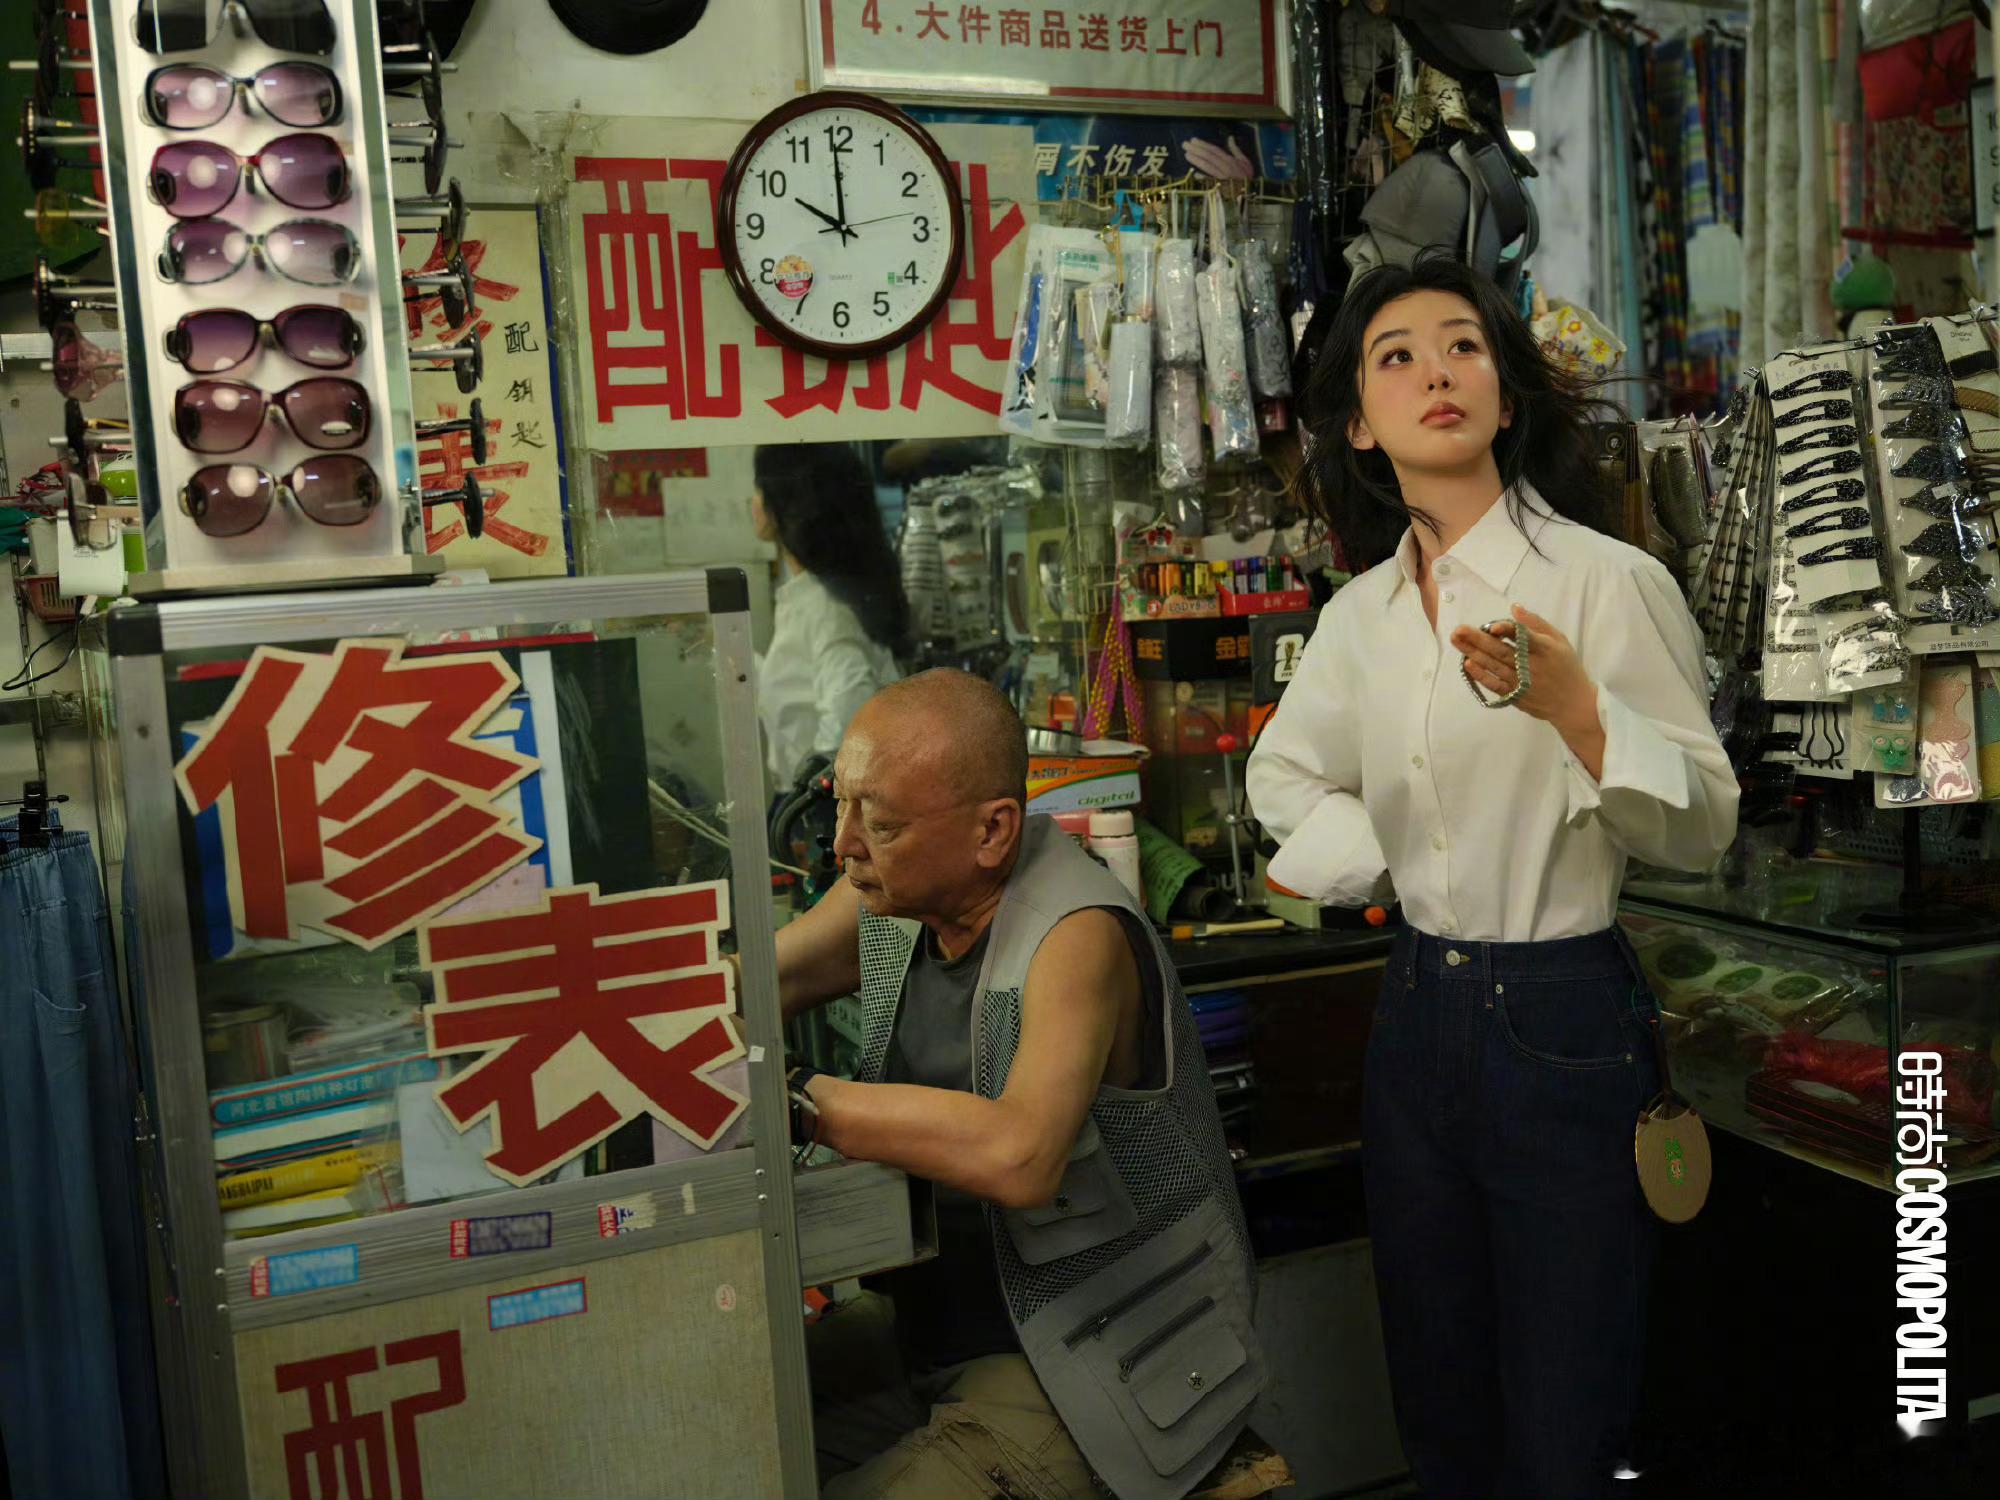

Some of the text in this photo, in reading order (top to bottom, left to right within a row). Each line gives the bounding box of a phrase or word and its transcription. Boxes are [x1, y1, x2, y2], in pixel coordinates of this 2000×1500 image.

[786, 135, 810, 164] 11
[823, 125, 853, 153] 12
[873, 138, 884, 166] 1
[756, 169, 787, 198] 10
[900, 171, 919, 198] 2
[746, 213, 765, 240] 9
[912, 215, 930, 243] 3
[760, 258, 776, 285] 8
[904, 260, 920, 285] 4
[833, 301, 851, 329] 6
[872, 291, 891, 317] 5
